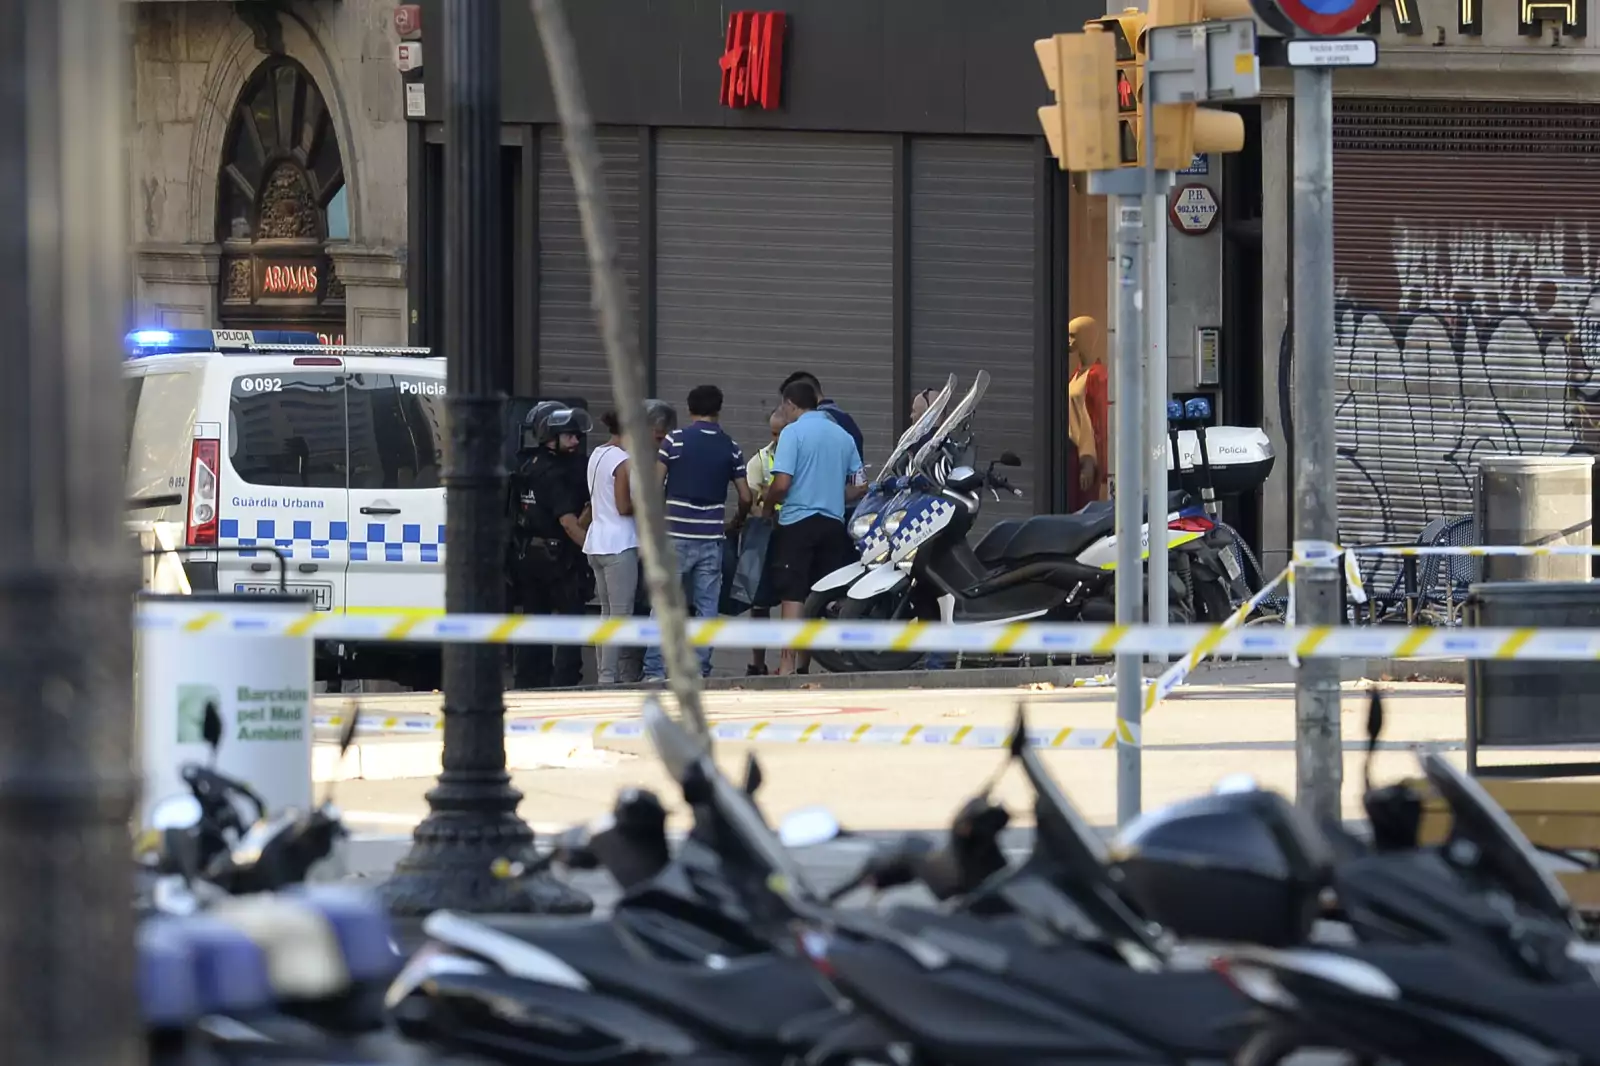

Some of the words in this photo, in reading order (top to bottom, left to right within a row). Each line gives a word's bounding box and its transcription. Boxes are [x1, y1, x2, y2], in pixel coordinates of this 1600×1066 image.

[719, 11, 780, 109] H&M
[1188, 189, 1206, 201] P.B.
[1177, 204, 1216, 213] 902.51.11.11
[262, 265, 318, 294] AROMAS
[216, 330, 251, 341] POLICIA
[254, 378, 283, 392] 092
[400, 381, 447, 395] Policia
[1219, 446, 1248, 454] Policia
[282, 497, 325, 508] Urbana
